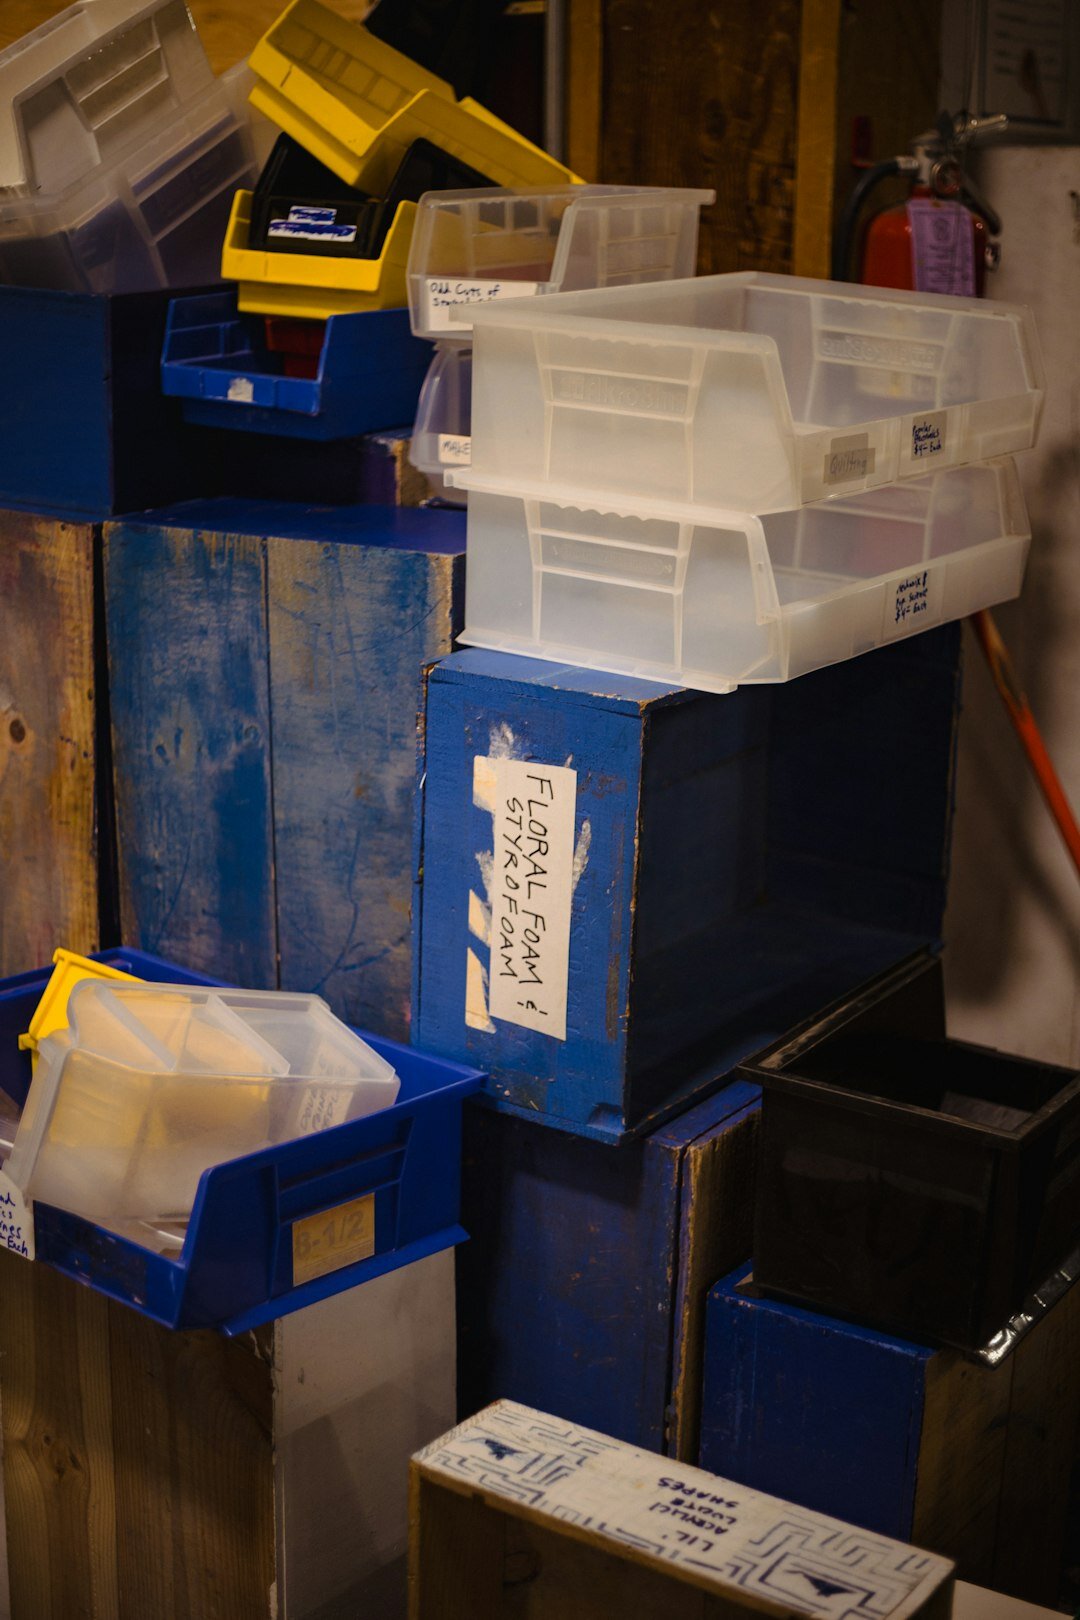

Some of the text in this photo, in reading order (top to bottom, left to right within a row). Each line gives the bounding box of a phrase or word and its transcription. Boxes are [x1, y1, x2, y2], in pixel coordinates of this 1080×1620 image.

[487, 284, 501, 296] of
[522, 774, 555, 900] FLORAL
[498, 796, 525, 979] STYROFOAM
[518, 909, 547, 986] FOAM
[658, 1477, 739, 1508] SHAPES
[669, 1497, 737, 1525] LUCITE
